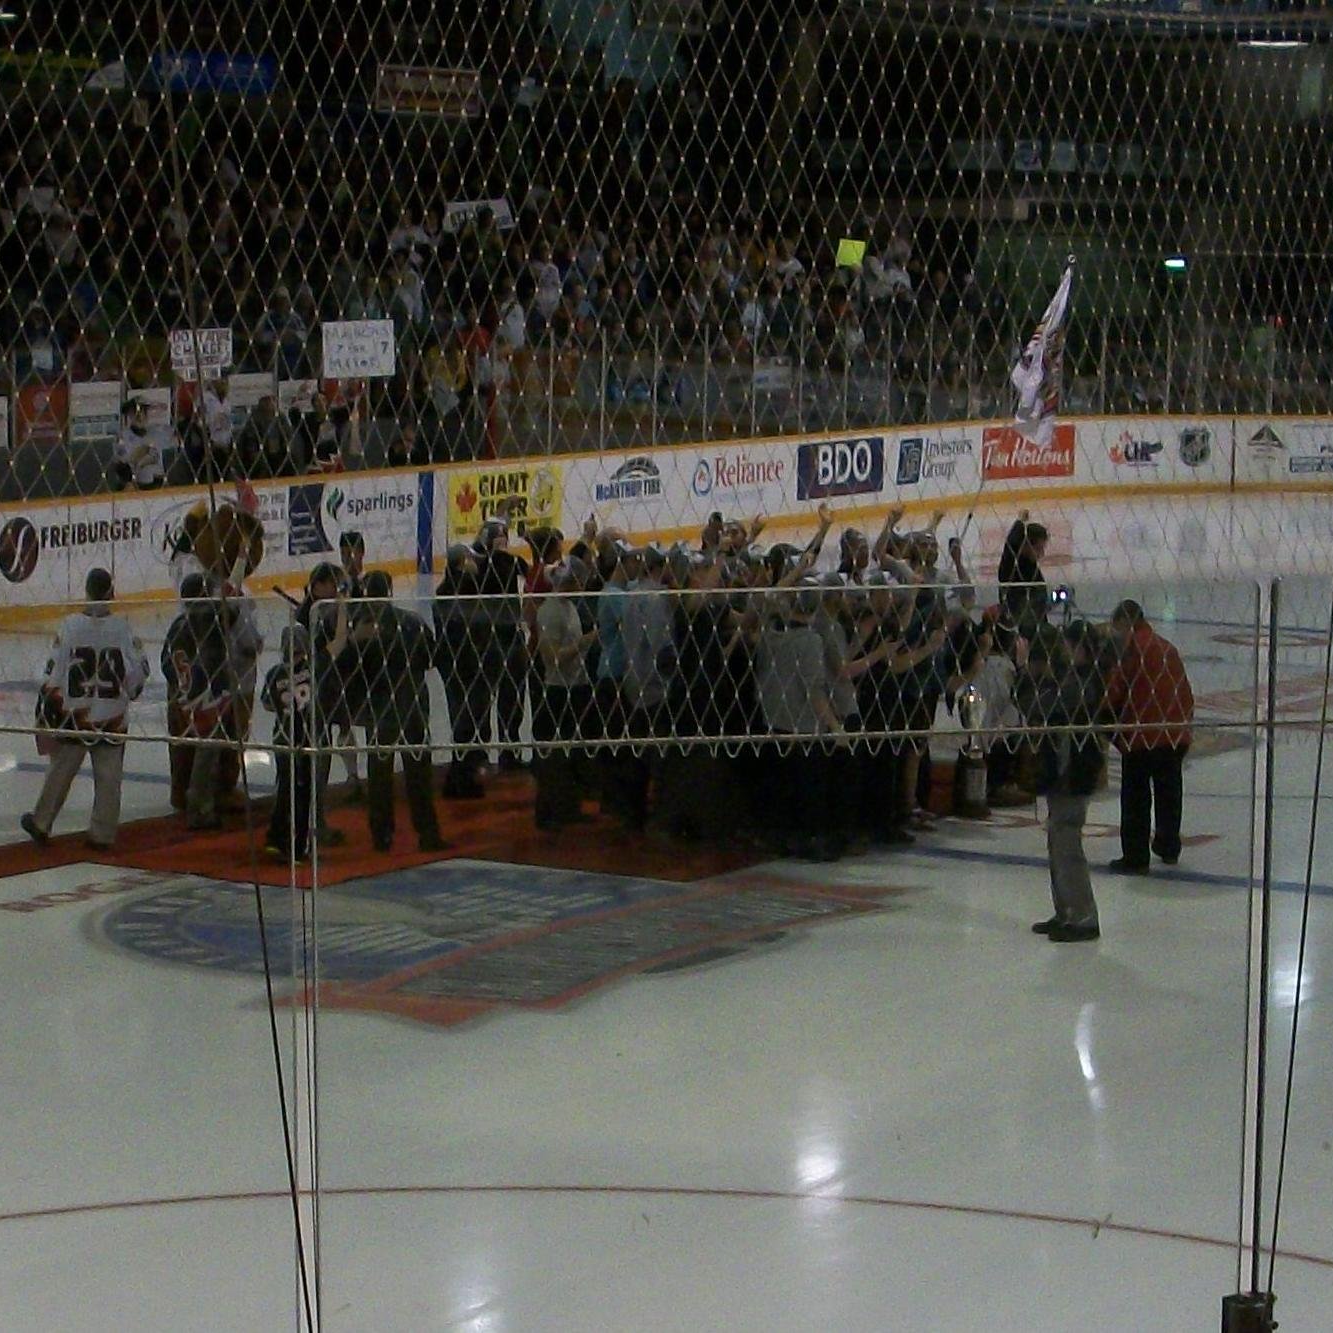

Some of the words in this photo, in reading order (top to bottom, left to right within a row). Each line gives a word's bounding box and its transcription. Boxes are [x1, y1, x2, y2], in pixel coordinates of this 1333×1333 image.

[923, 438, 972, 455] Investors
[715, 454, 784, 487] Reliance
[818, 440, 873, 486] BDO
[922, 458, 955, 480] Group
[479, 472, 529, 498] GIANT
[347, 492, 414, 516] sparlings
[41, 517, 142, 549] FREIBURGER
[68, 646, 126, 698] 29
